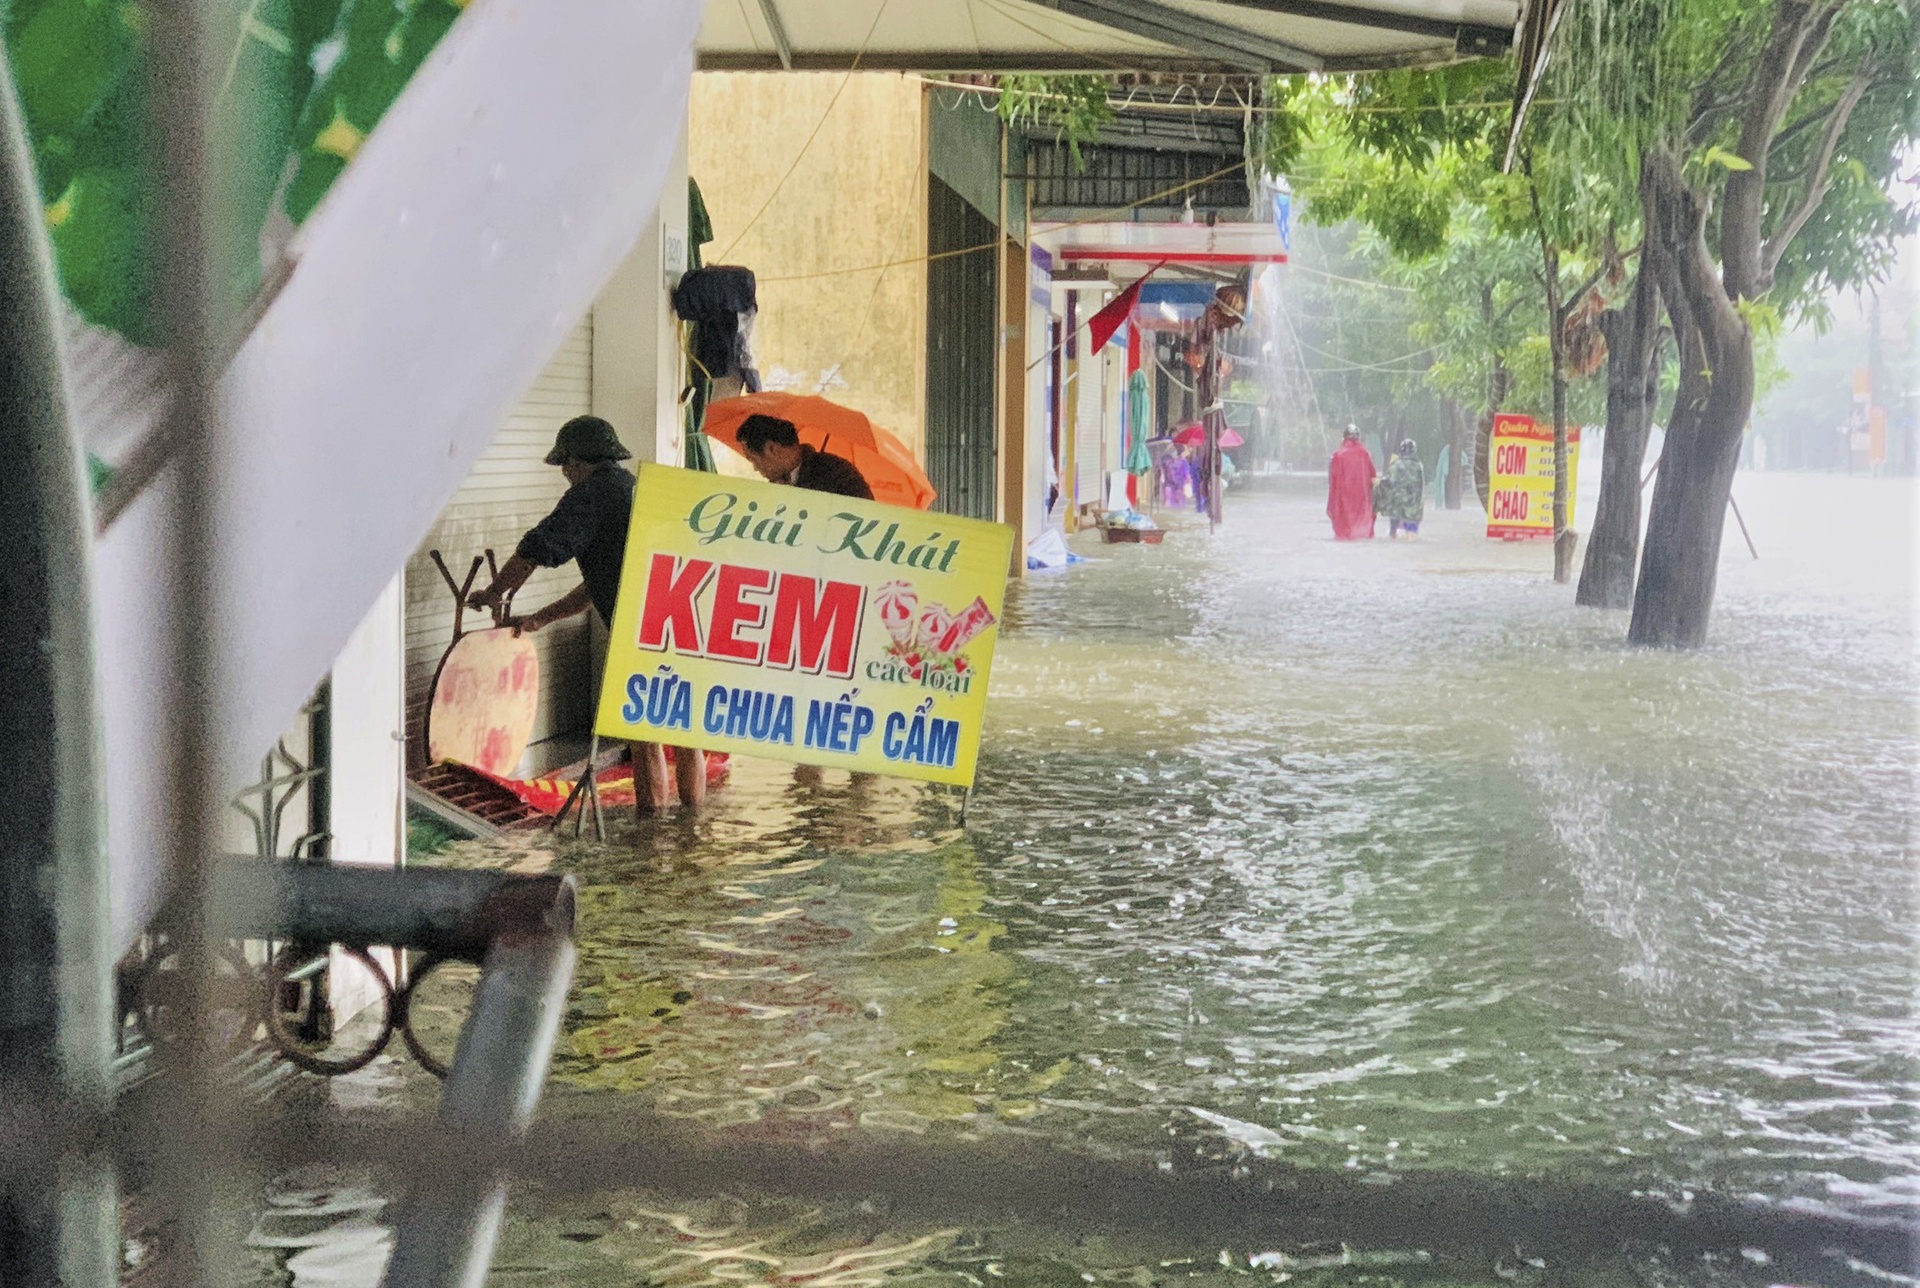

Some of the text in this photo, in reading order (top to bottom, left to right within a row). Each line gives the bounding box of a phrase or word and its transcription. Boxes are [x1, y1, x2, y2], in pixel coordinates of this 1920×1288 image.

[1496, 443, 1527, 475] CƠM
[816, 512, 960, 573] Khát
[638, 552, 867, 679] KEM
[866, 657, 972, 698] các loại
[622, 664, 960, 767] SỮA CHUA NẾP CẨM
